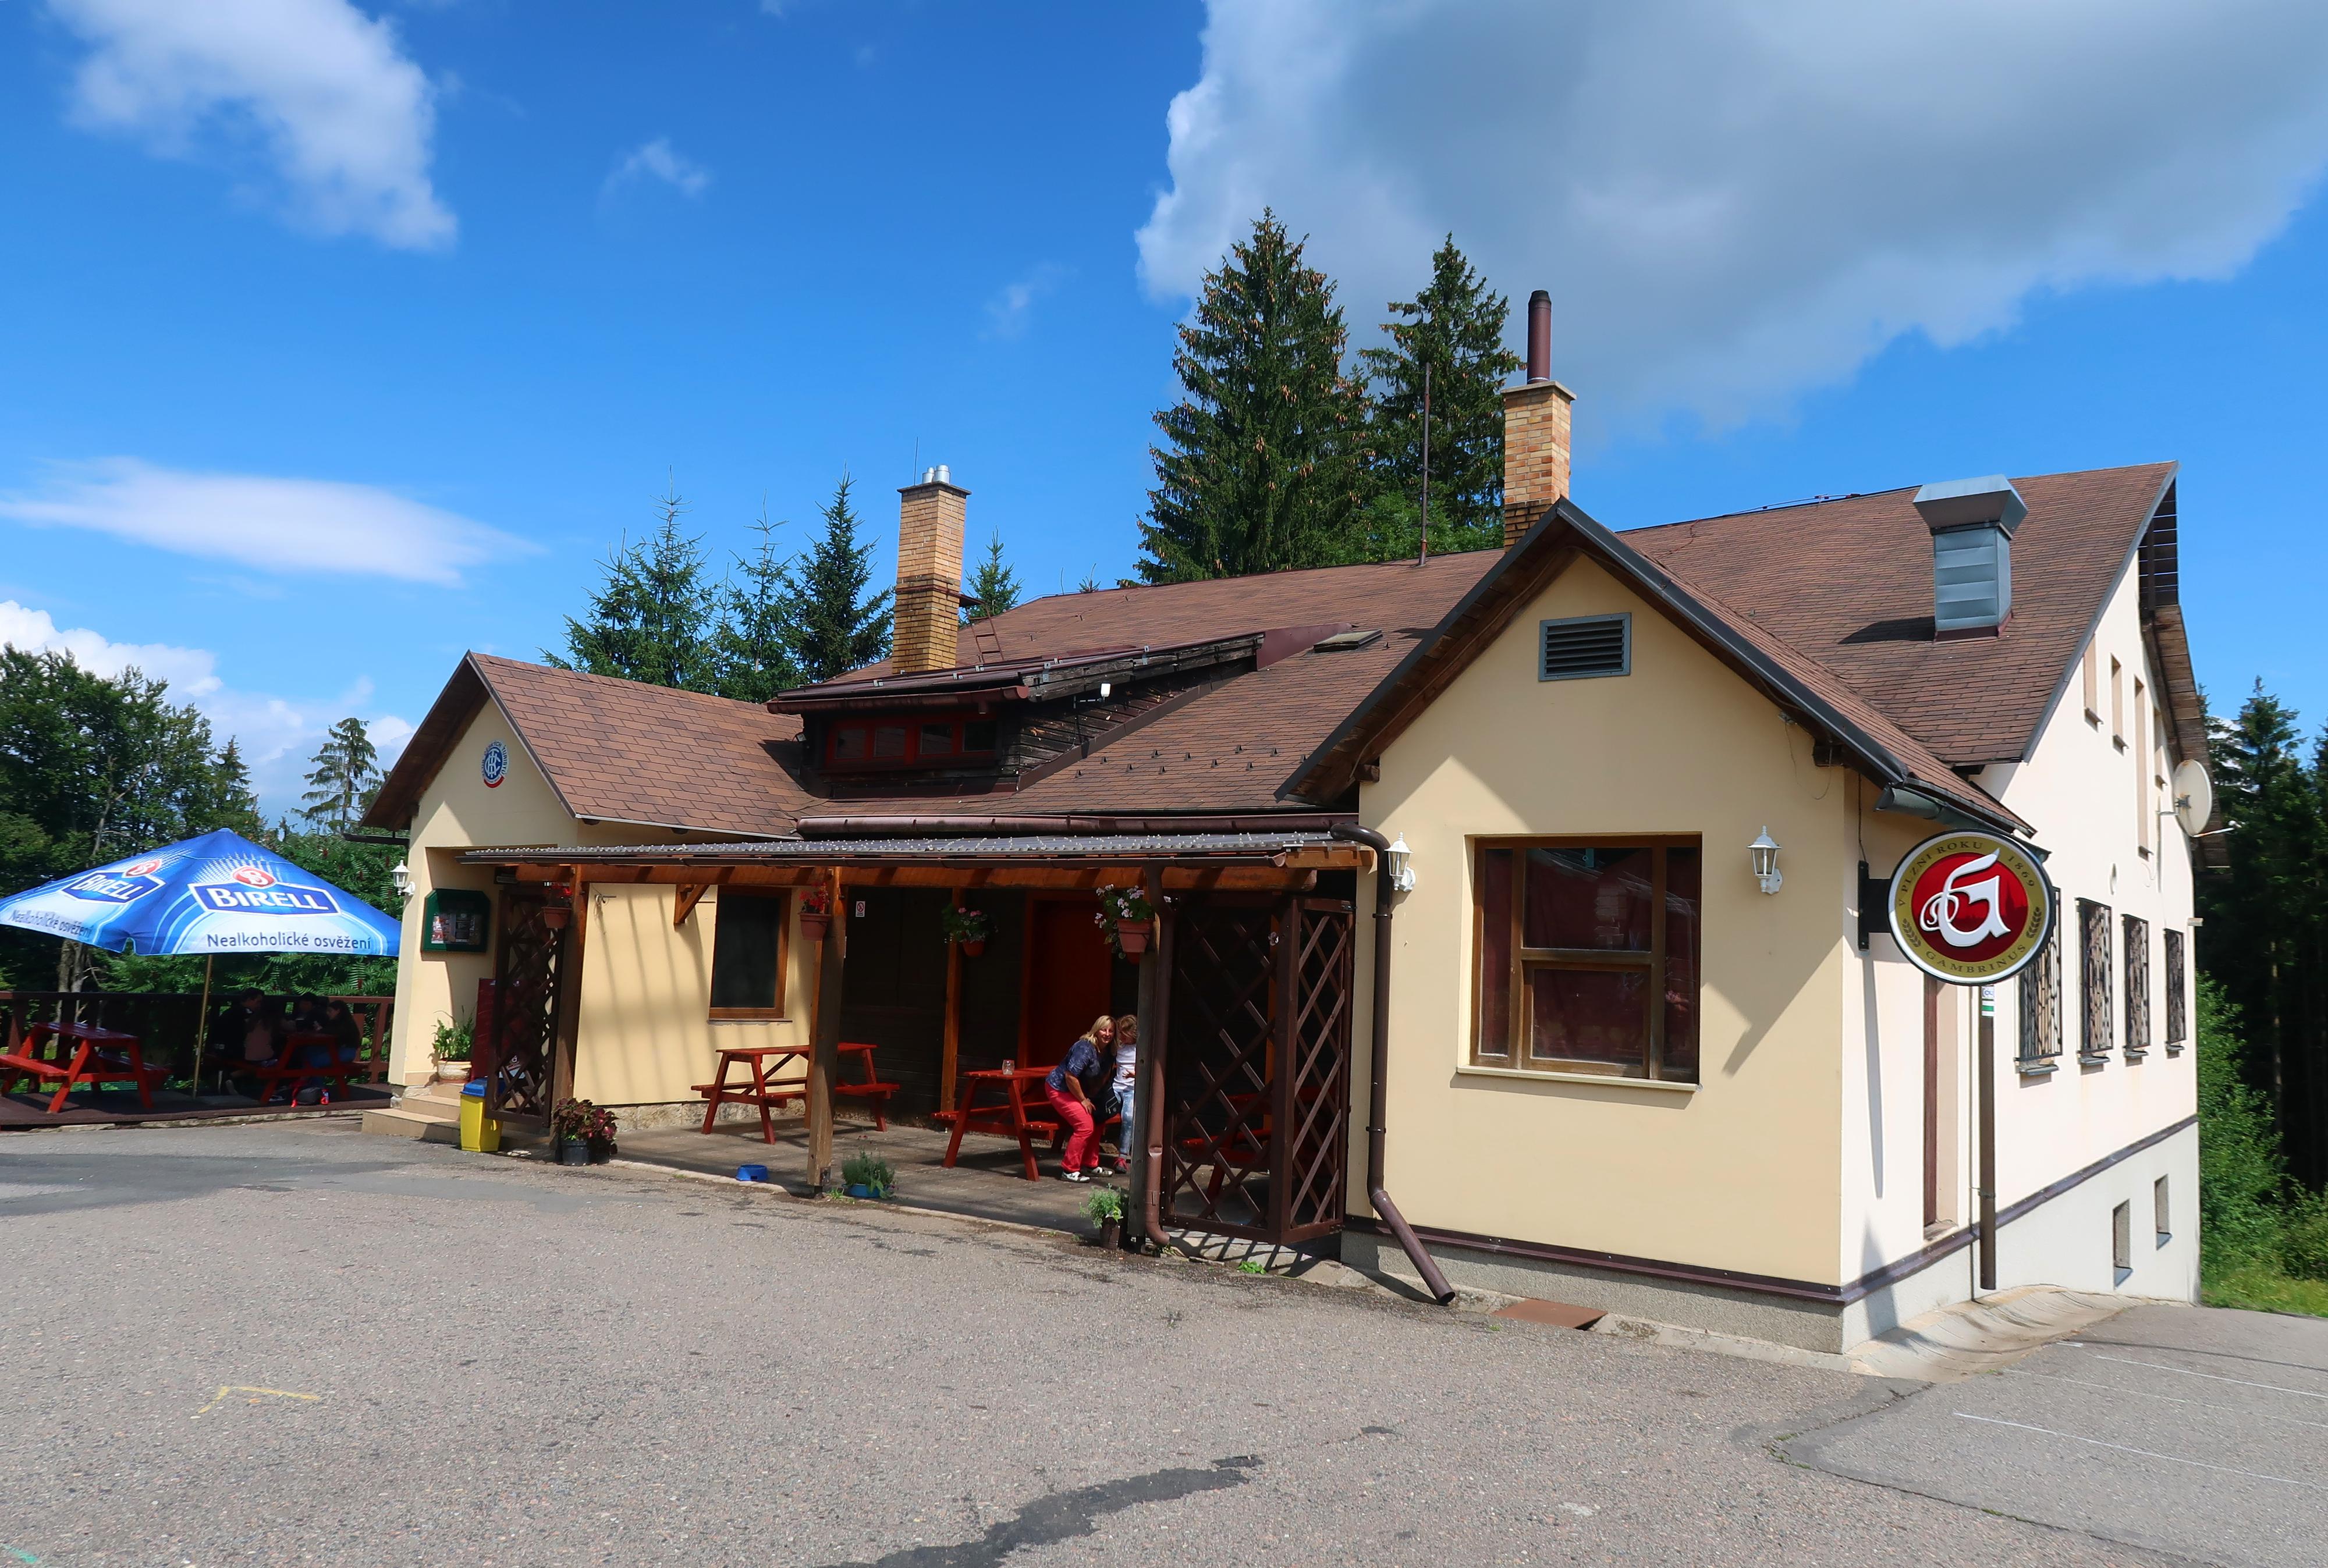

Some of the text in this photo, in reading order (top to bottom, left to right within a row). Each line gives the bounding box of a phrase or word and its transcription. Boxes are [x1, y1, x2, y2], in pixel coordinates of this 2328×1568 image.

[1901, 854, 1932, 893] PLZNI
[1936, 841, 1983, 854] ROKU
[2008, 855, 2035, 887] 1869
[71, 874, 143, 899] BIRELL
[206, 887, 329, 911] BIRELL
[207, 932, 371, 950] Nealkoholické osvěžení
[1926, 944, 2025, 973] GAMBRINUS
